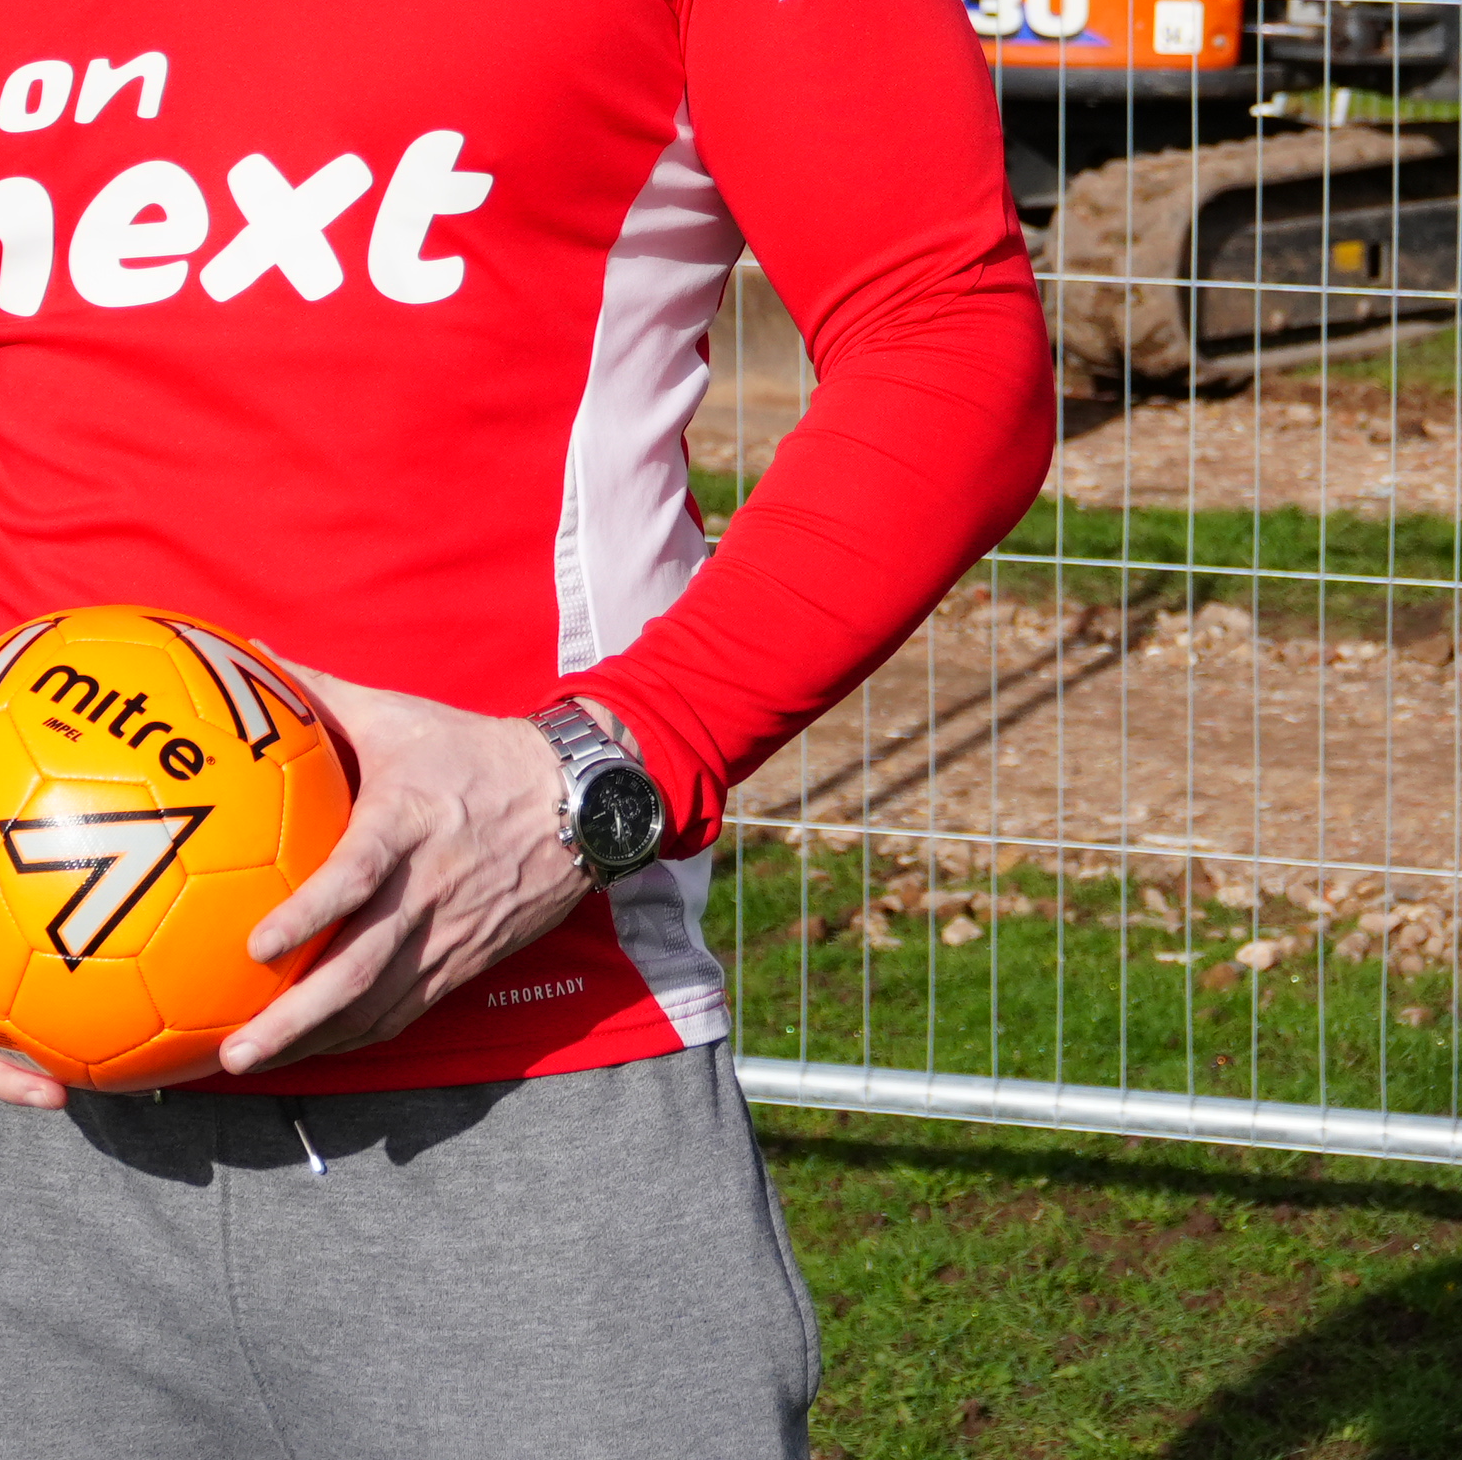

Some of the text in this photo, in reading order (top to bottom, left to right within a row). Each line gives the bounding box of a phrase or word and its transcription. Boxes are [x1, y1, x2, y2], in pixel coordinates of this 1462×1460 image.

[29, 665, 205, 782] mitre
[42, 717, 84, 743] IMPEL
[487, 977, 584, 1008] AEROREADY
